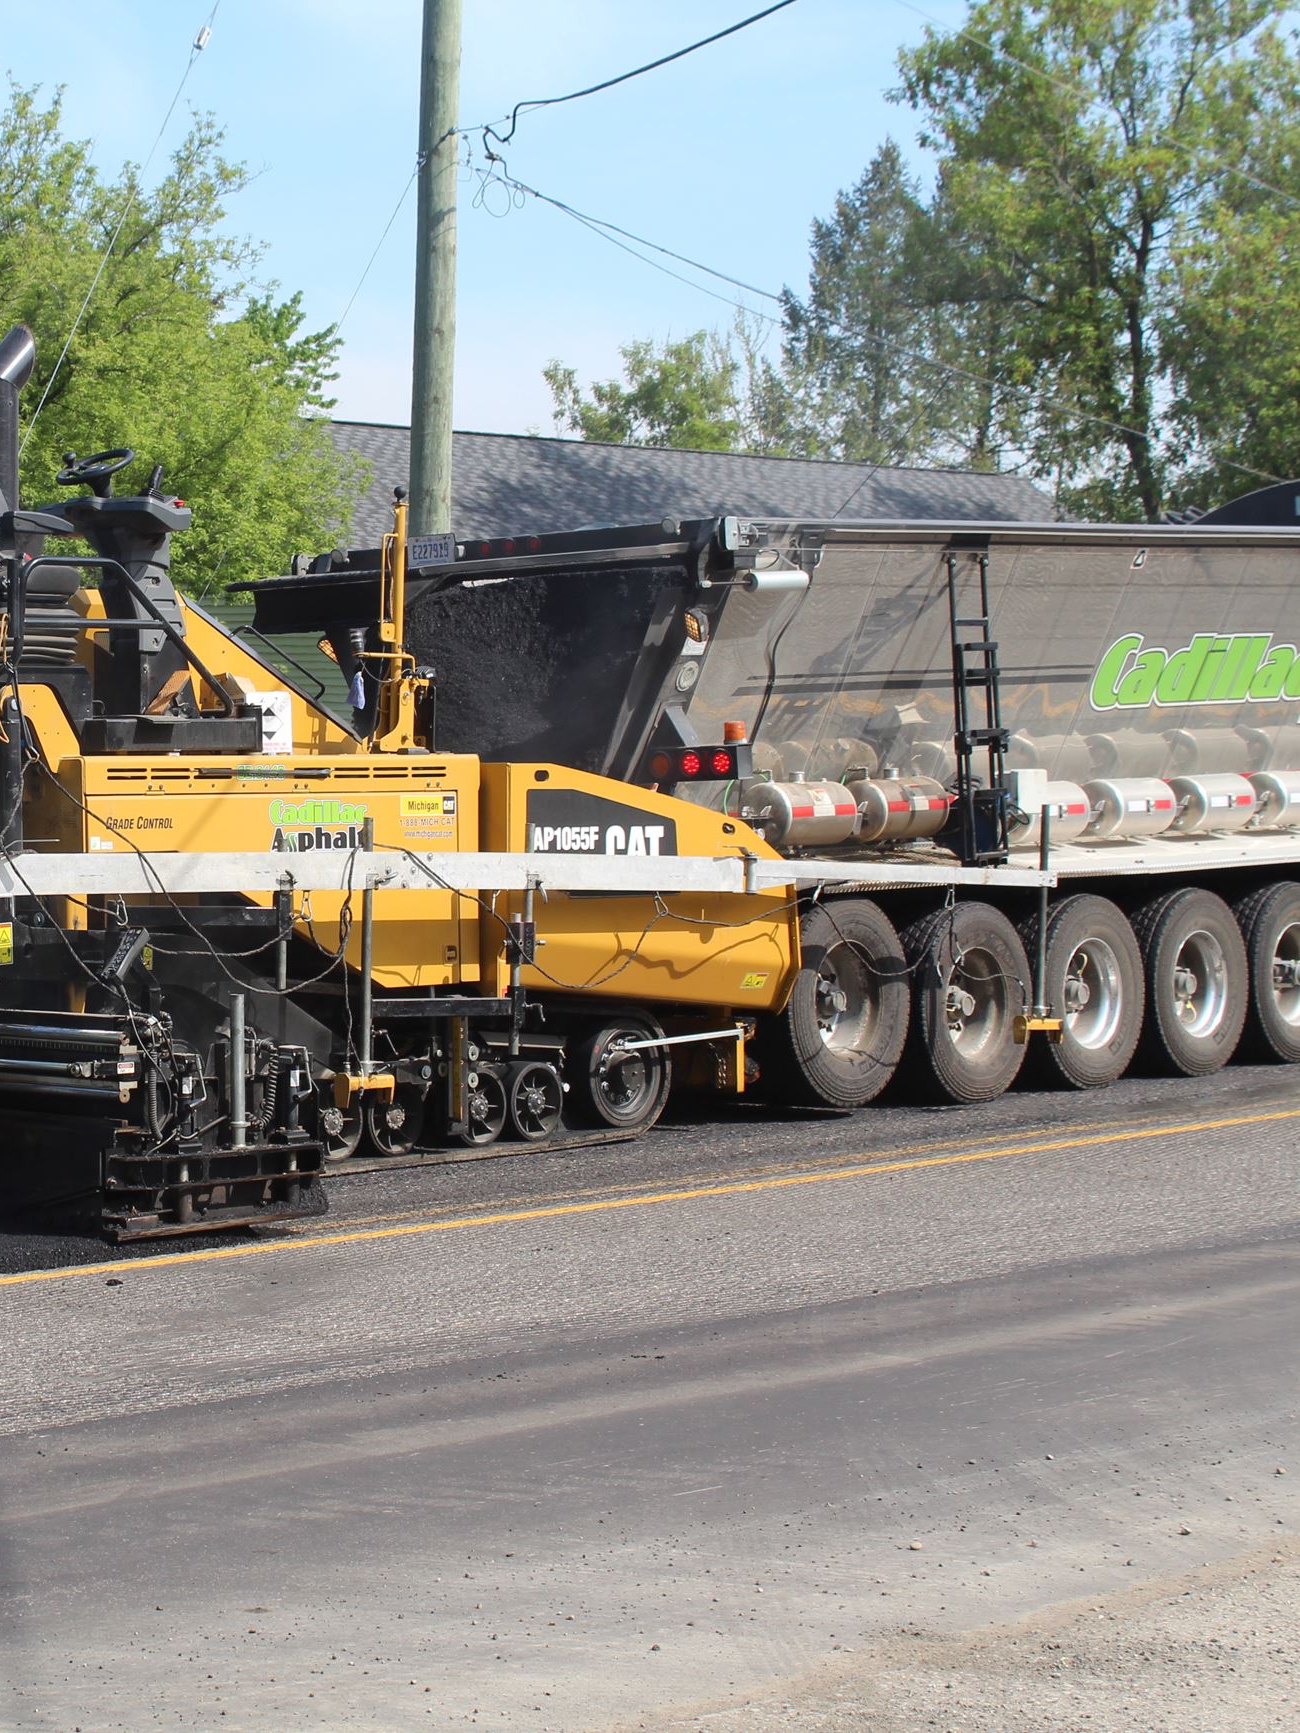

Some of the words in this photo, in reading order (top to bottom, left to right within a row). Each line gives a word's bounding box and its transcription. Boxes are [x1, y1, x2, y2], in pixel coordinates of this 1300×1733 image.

[407, 801, 439, 812] Michigan
[440, 817, 455, 826] CAT
[533, 826, 599, 850] AP1055F
[605, 825, 664, 856] CAT
